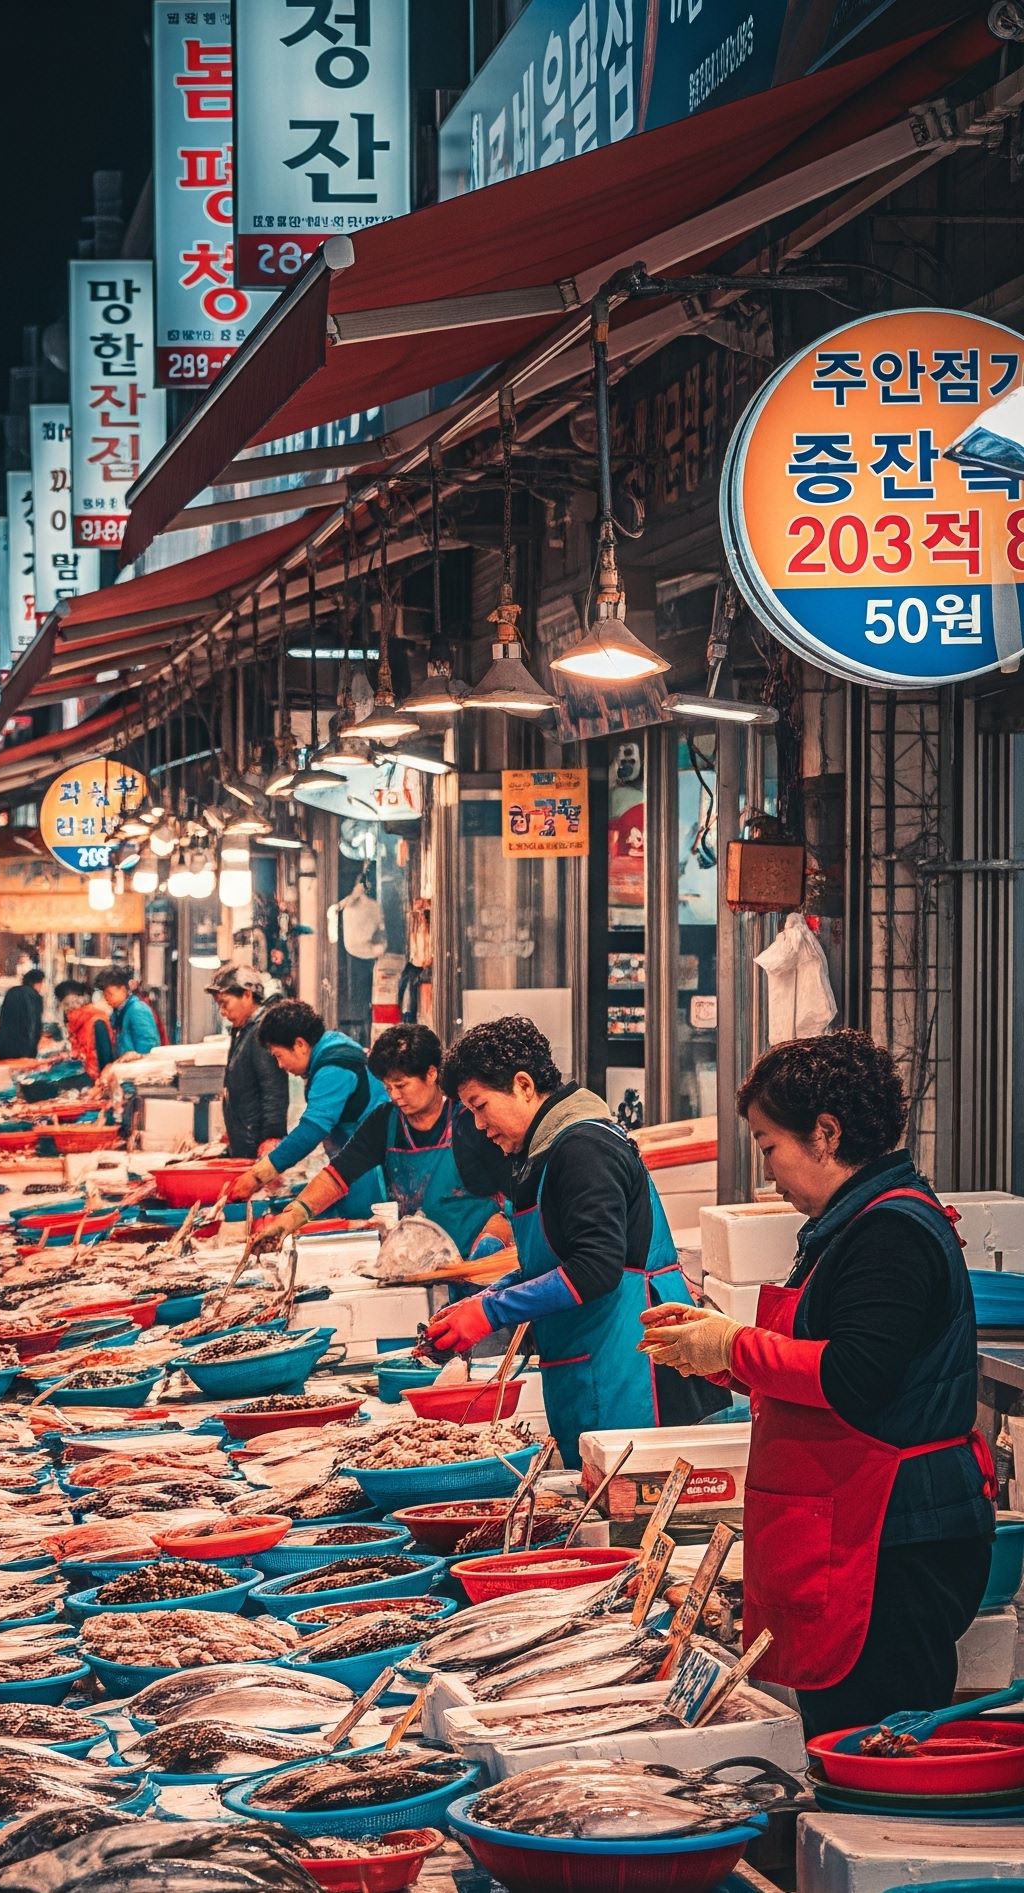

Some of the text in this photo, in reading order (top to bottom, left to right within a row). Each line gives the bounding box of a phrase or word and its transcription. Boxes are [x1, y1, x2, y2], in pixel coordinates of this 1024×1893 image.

[279, 0, 390, 204] 정잔
[787, 510, 981, 575] 203적
[864, 595, 983, 645] 50원
